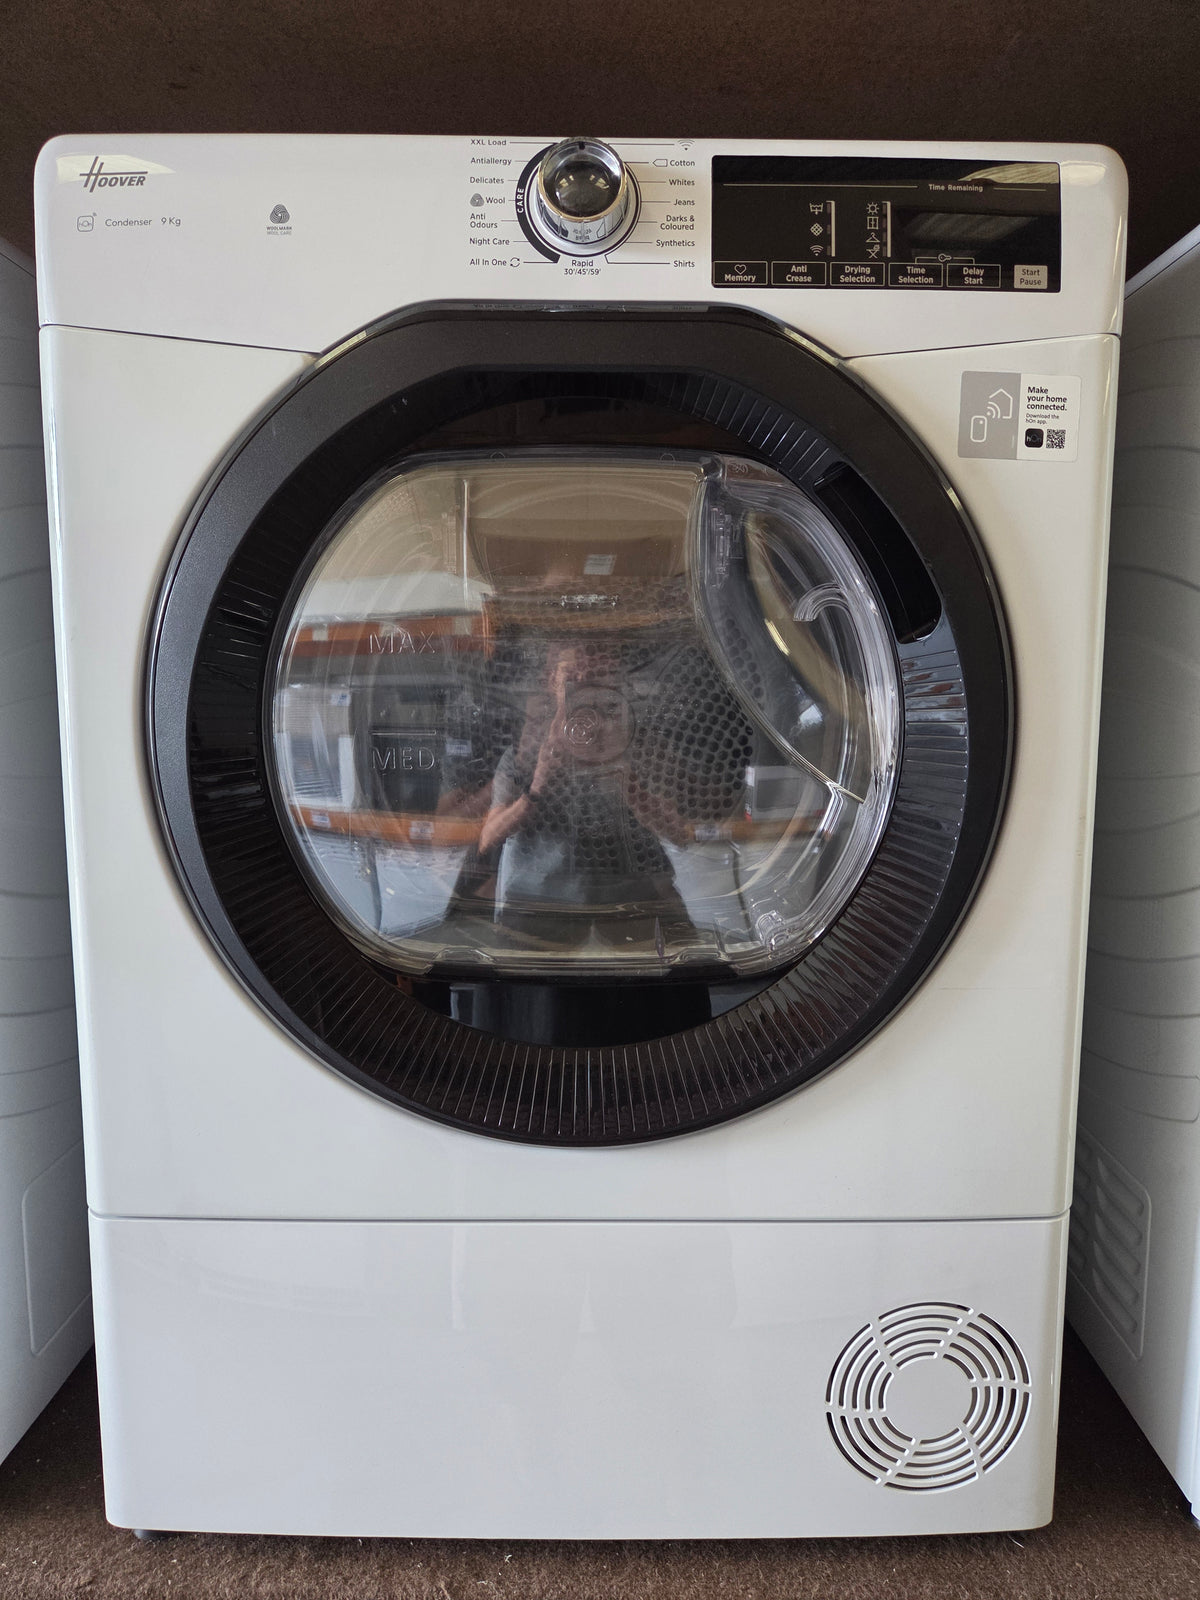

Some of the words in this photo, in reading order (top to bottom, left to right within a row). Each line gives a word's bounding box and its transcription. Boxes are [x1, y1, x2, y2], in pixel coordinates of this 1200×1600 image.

[470, 157, 512, 166] Antiallergy
[669, 159, 696, 167] Cotton
[928, 184, 945, 192] Time
[947, 184, 984, 193] Remaining
[485, 196, 506, 204] Wool
[517, 187, 525, 214] CARE
[470, 213, 486, 221] Anti
[104, 217, 153, 228] Condenser
[160, 217, 167, 226] 9
[168, 217, 181, 227] Kg
[469, 221, 498, 229] Odours
[660, 223, 695, 231] Coloured
[469, 238, 490, 247] Night
[491, 238, 510, 246] Care
[656, 239, 695, 248] Synthetics
[571, 259, 594, 268] Rapid
[673, 260, 695, 268] Shirts
[790, 265, 807, 273] Anti
[844, 265, 871, 274] Drying
[906, 266, 926, 274] Time
[962, 267, 985, 276] Delay
[724, 274, 756, 283] Memory
[785, 275, 812, 283] Crease
[839, 275, 876, 283] Selection
[898, 275, 934, 284] Selection
[963, 277, 984, 285] Start
[1019, 278, 1042, 286] Pause
[1027, 386, 1048, 394] Make
[1027, 395, 1044, 403] your
[1045, 395, 1068, 403] home
[1026, 403, 1068, 411] connected.
[369, 631, 436, 654] MAX
[371, 747, 435, 770] MED
